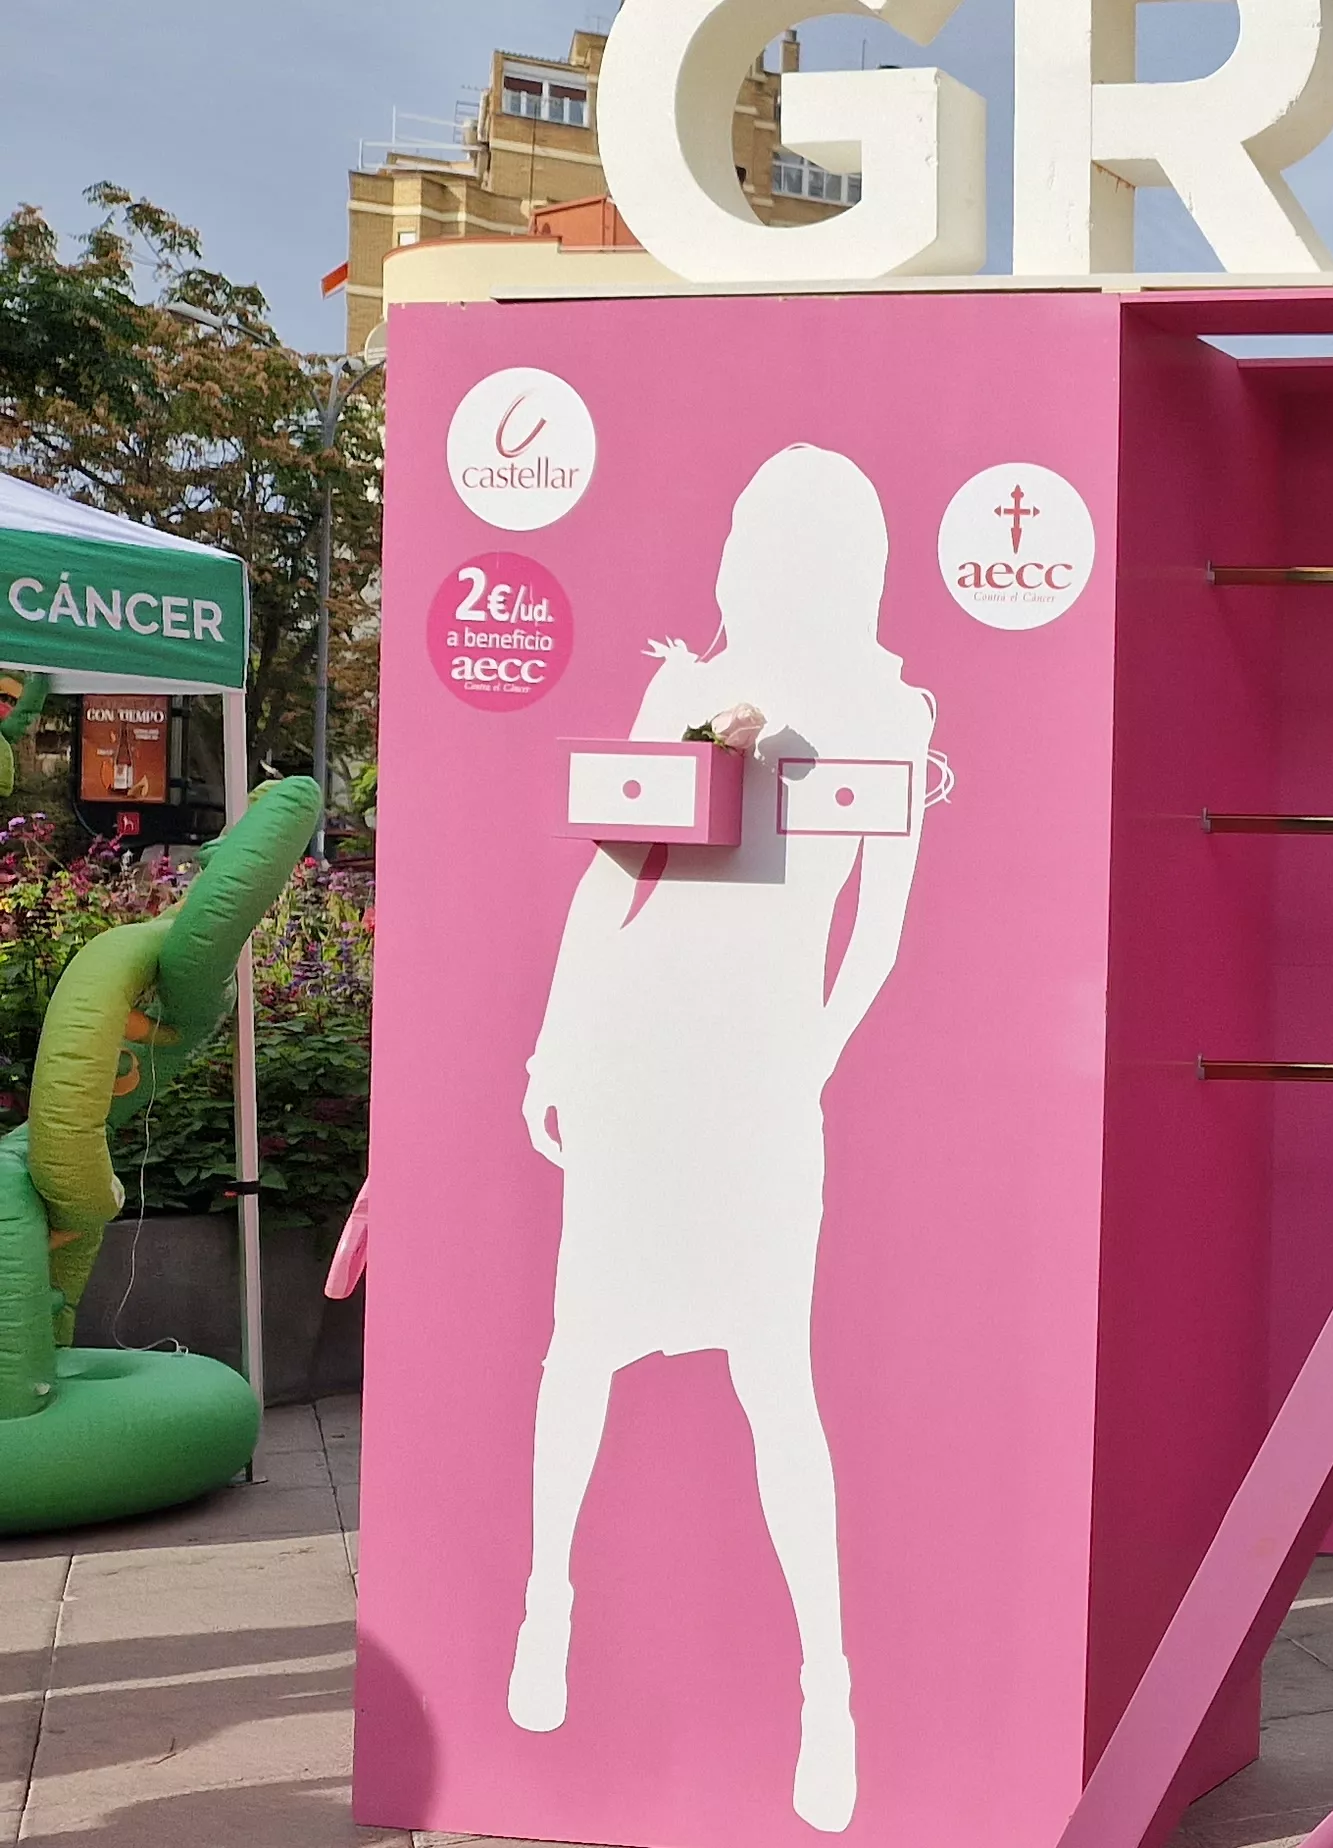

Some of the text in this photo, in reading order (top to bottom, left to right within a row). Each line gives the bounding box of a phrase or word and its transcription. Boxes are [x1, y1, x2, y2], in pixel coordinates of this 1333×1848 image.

[462, 456, 580, 489] castellar
[957, 561, 1074, 590] aecc
[8, 571, 225, 642] CÁNCER
[455, 566, 556, 624] 2€/ud.
[973, 592, 1006, 602] Contra
[1010, 592, 1018, 602] el
[446, 627, 554, 651] a beneficio
[450, 655, 548, 684] aecc
[86, 707, 165, 723] CON TIEMPO
